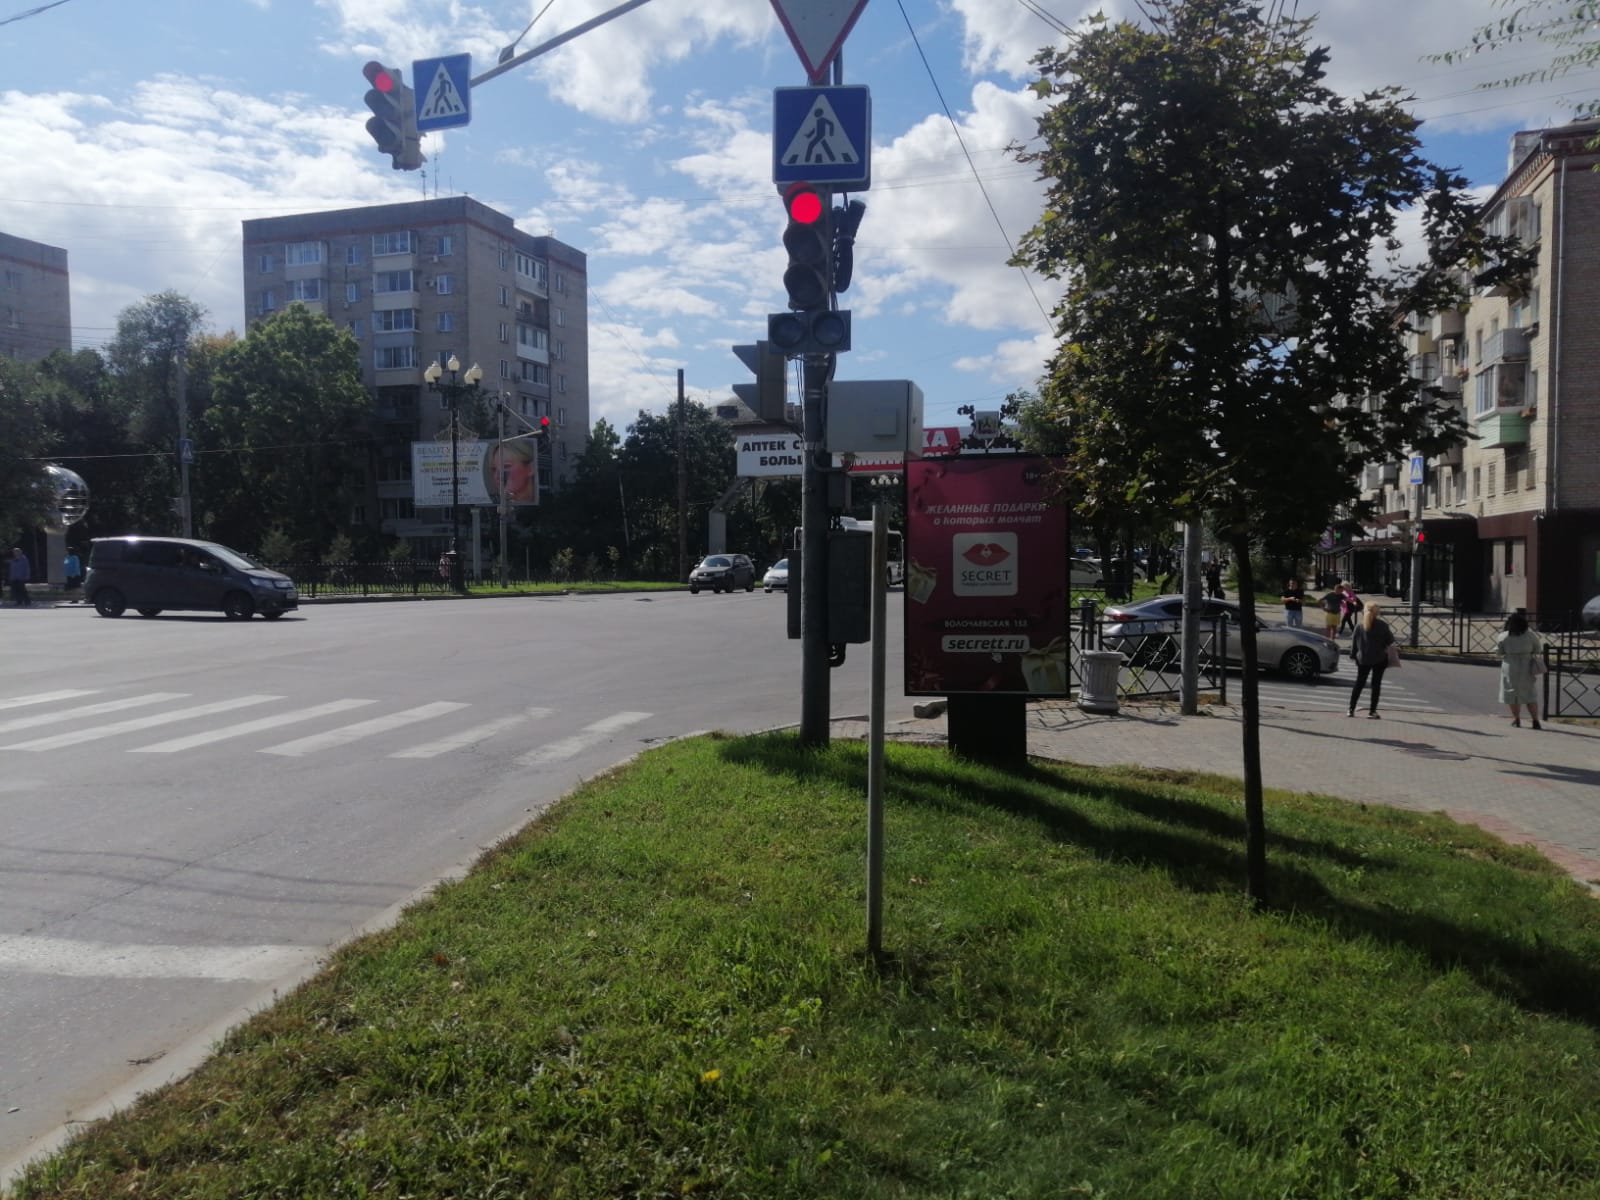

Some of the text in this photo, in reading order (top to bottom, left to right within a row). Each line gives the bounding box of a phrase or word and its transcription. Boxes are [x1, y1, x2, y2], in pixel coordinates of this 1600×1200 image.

[742, 440, 785, 452] АПТЕК
[926, 503, 990, 514] ЖЕЛАННЫЕ
[943, 515, 994, 527] которых
[961, 569, 1012, 582] SECRET
[944, 618, 1009, 628] ВОЛОЧАЕВСКАЯ
[948, 638, 1025, 650] secrett.ru
